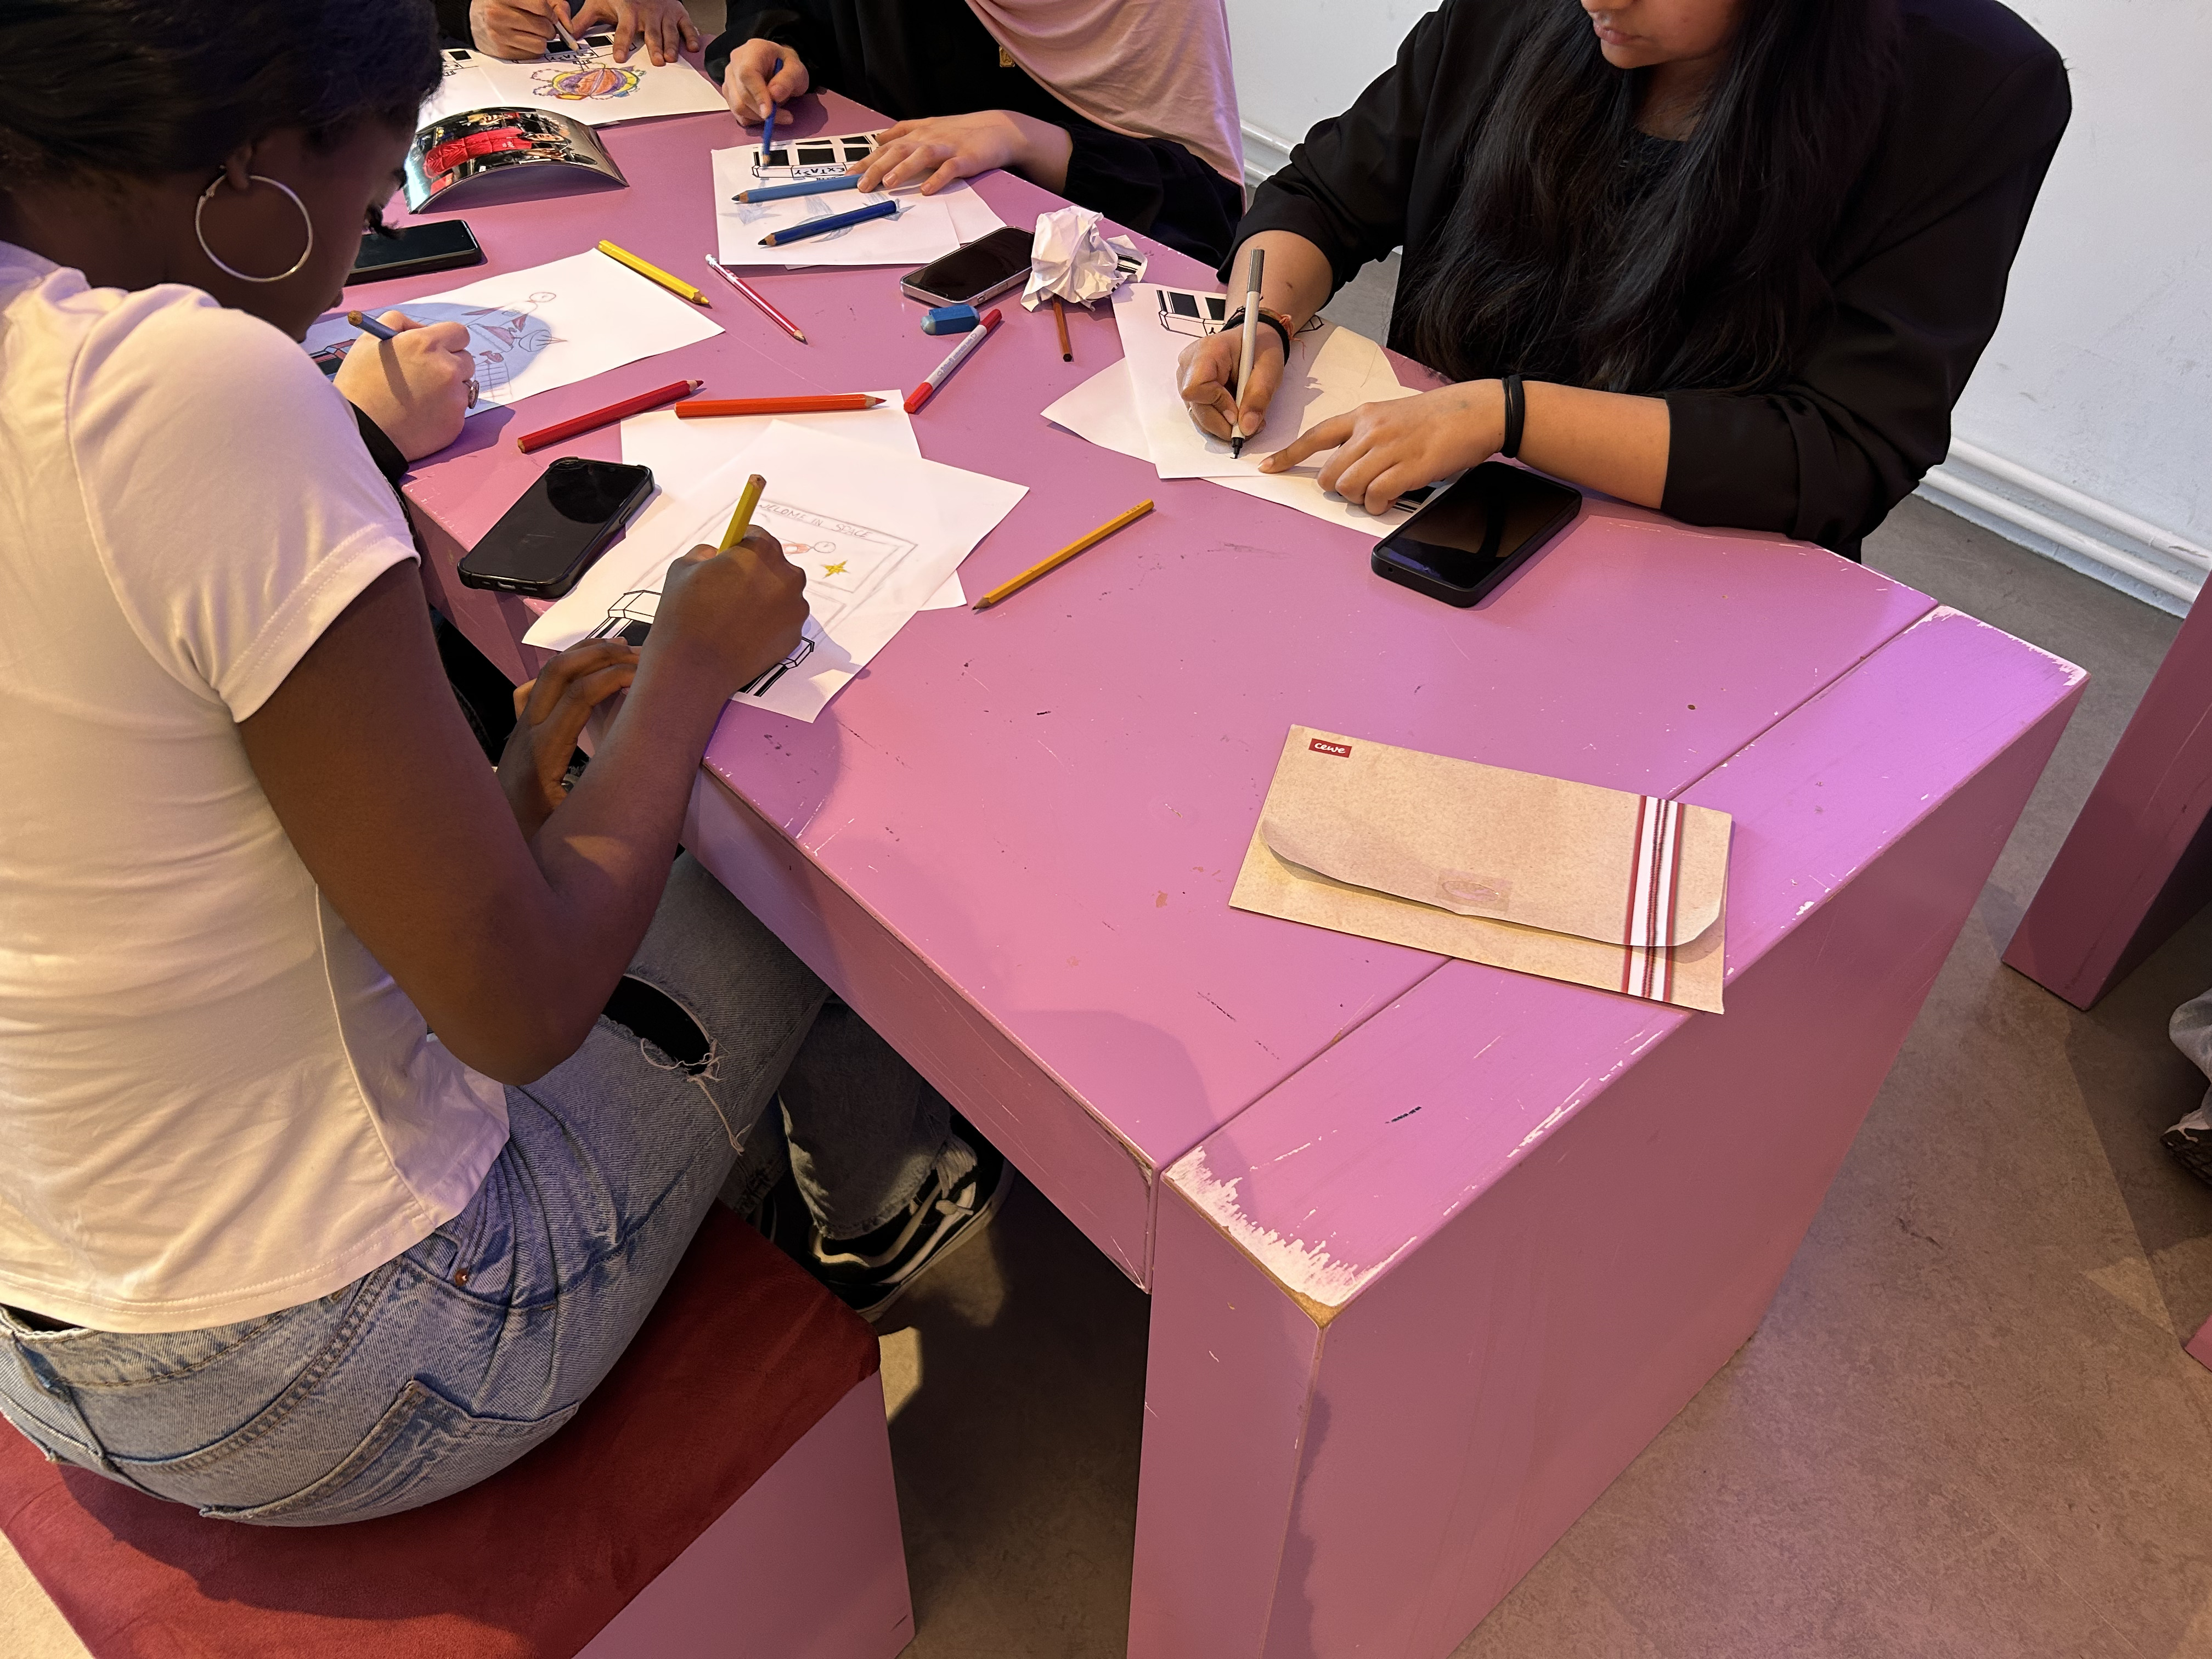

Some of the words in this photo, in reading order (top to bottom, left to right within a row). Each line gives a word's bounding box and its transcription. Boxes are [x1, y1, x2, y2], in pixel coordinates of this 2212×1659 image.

[794, 167, 845, 176] EXTASY
[811, 518, 823, 527] IN
[831, 523, 873, 538] SPACE
[1314, 742, 1346, 754] cewe
